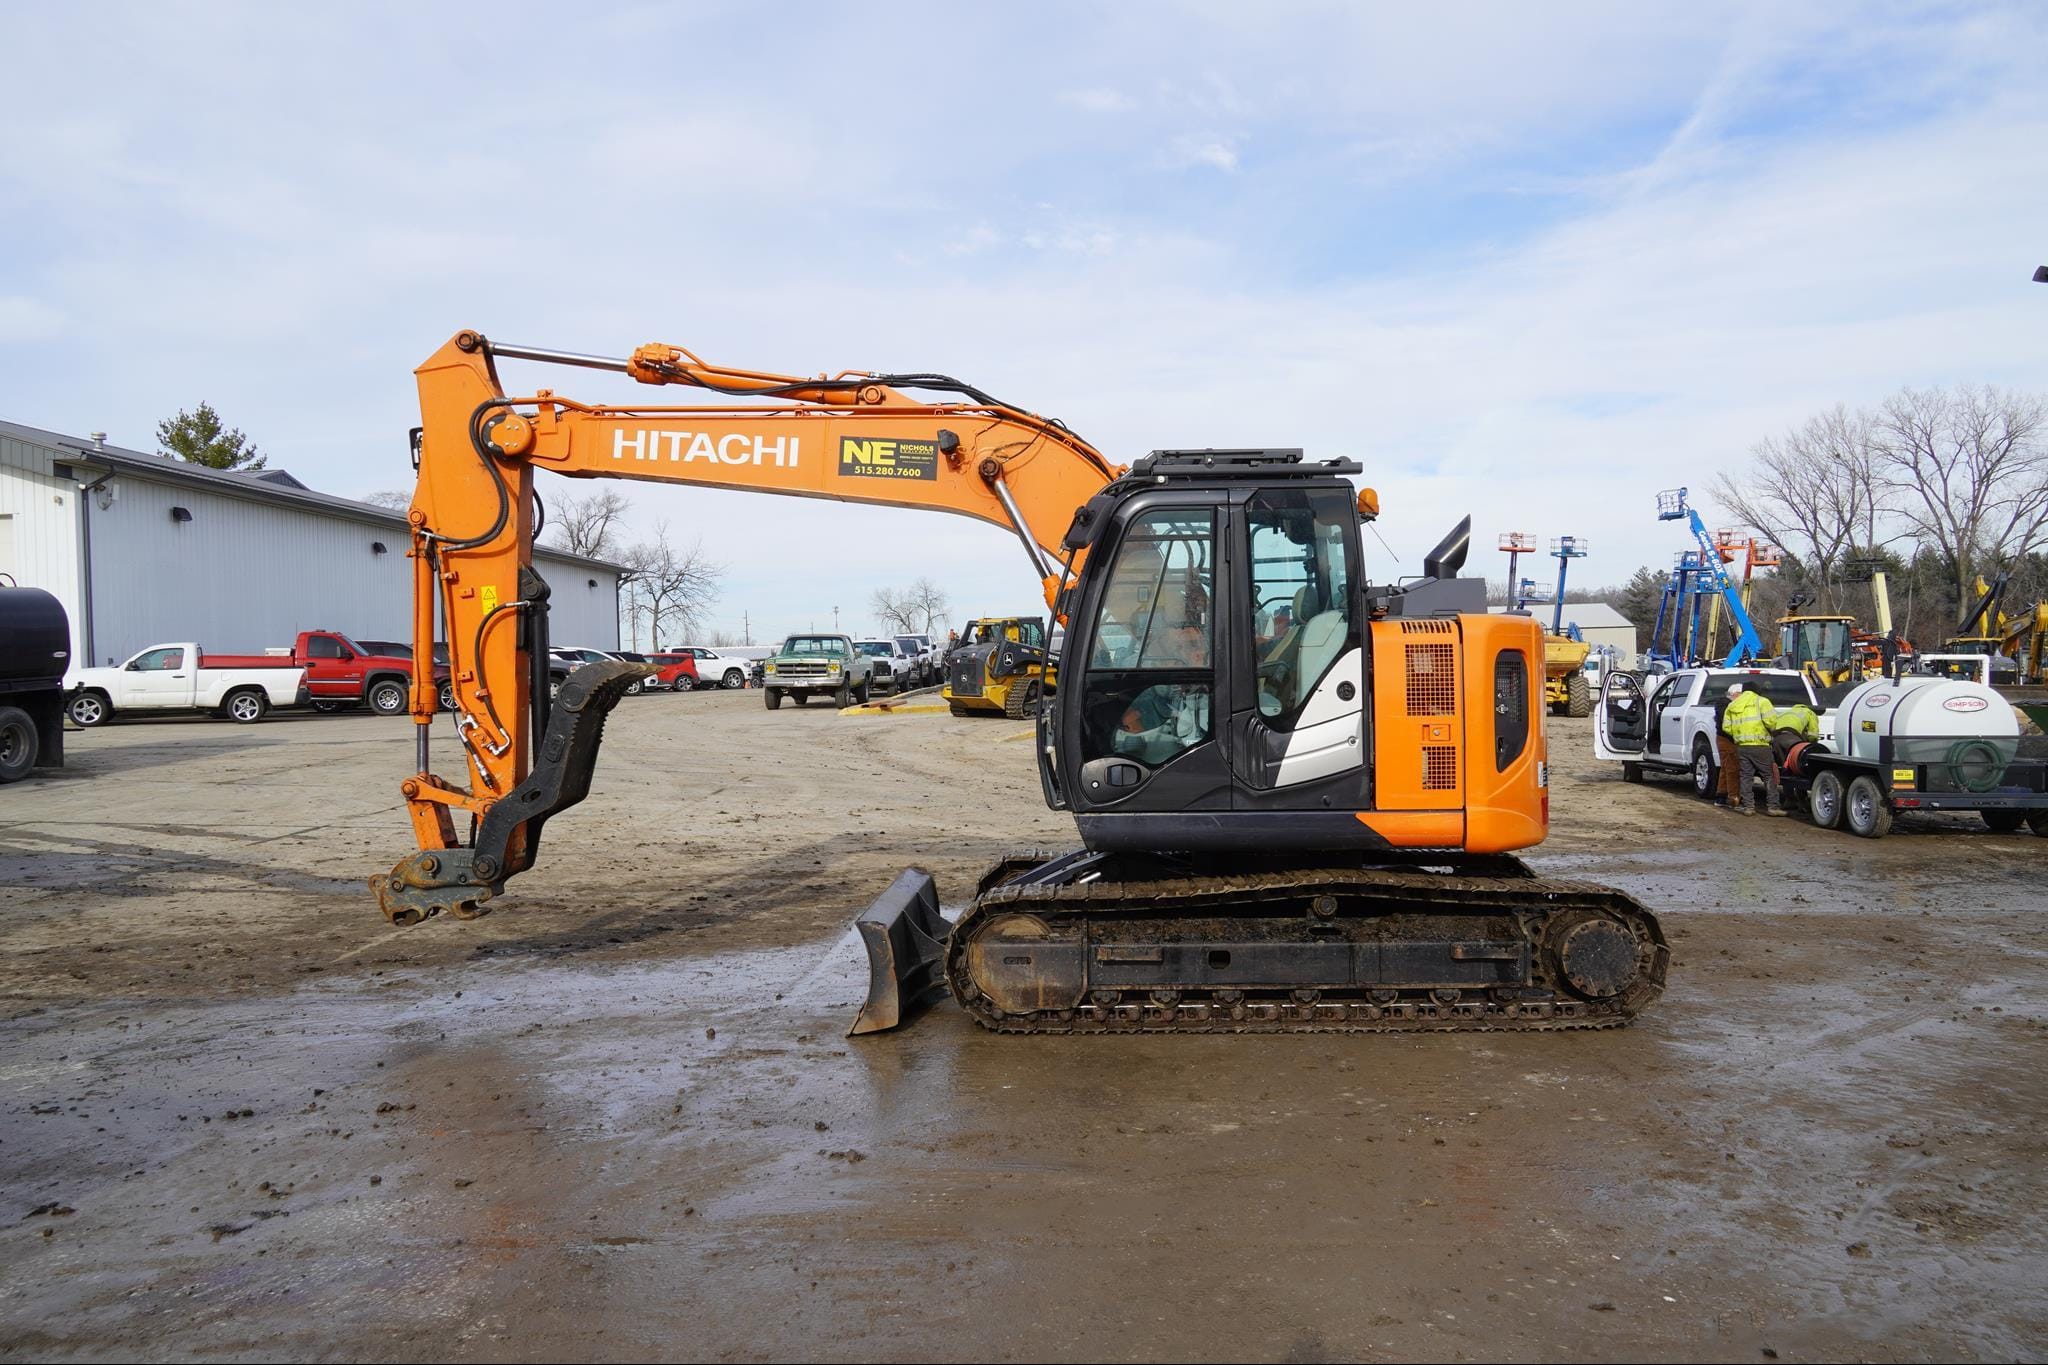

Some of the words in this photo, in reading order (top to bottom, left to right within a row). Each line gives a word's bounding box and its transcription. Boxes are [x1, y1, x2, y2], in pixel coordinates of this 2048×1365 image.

[613, 429, 799, 467] HITACHI
[843, 440, 896, 465] NE
[854, 466, 921, 477] 515.280.7600
